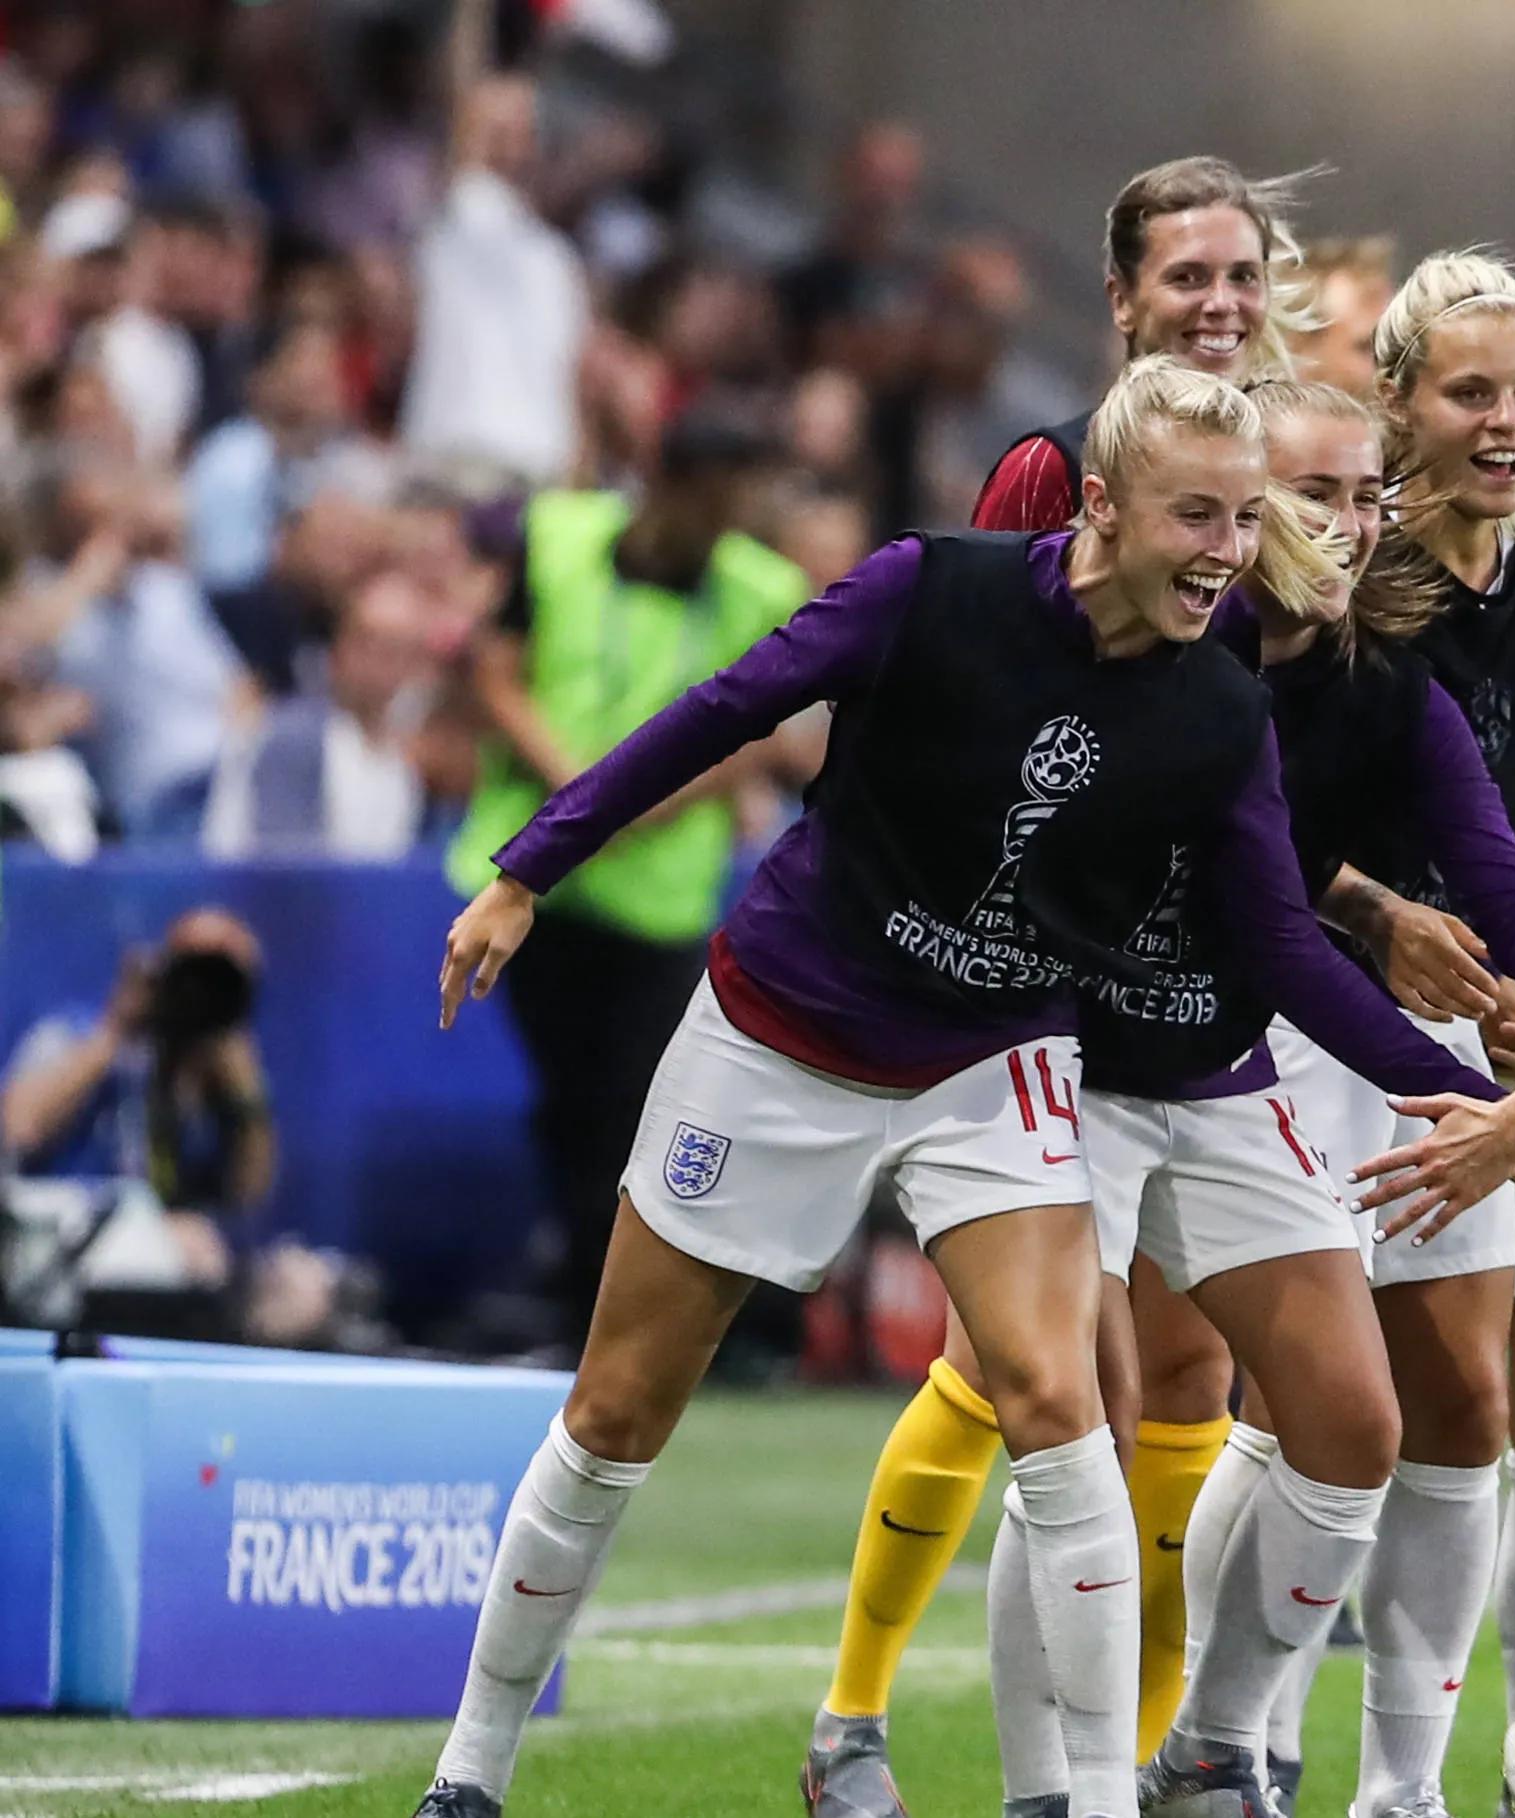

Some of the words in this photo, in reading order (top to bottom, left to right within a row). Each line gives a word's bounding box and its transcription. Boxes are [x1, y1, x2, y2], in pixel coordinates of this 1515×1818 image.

[885, 911, 1008, 989] FRANCE
[908, 900, 980, 952] WOMEN'S
[984, 940, 1039, 967] WORLD
[975, 909, 1014, 930] FIFA
[1136, 933, 1172, 953] FIFA
[1007, 1047, 1080, 1141] 14
[228, 1519, 397, 1614] FRANCE
[400, 1521, 495, 1608] 2019
